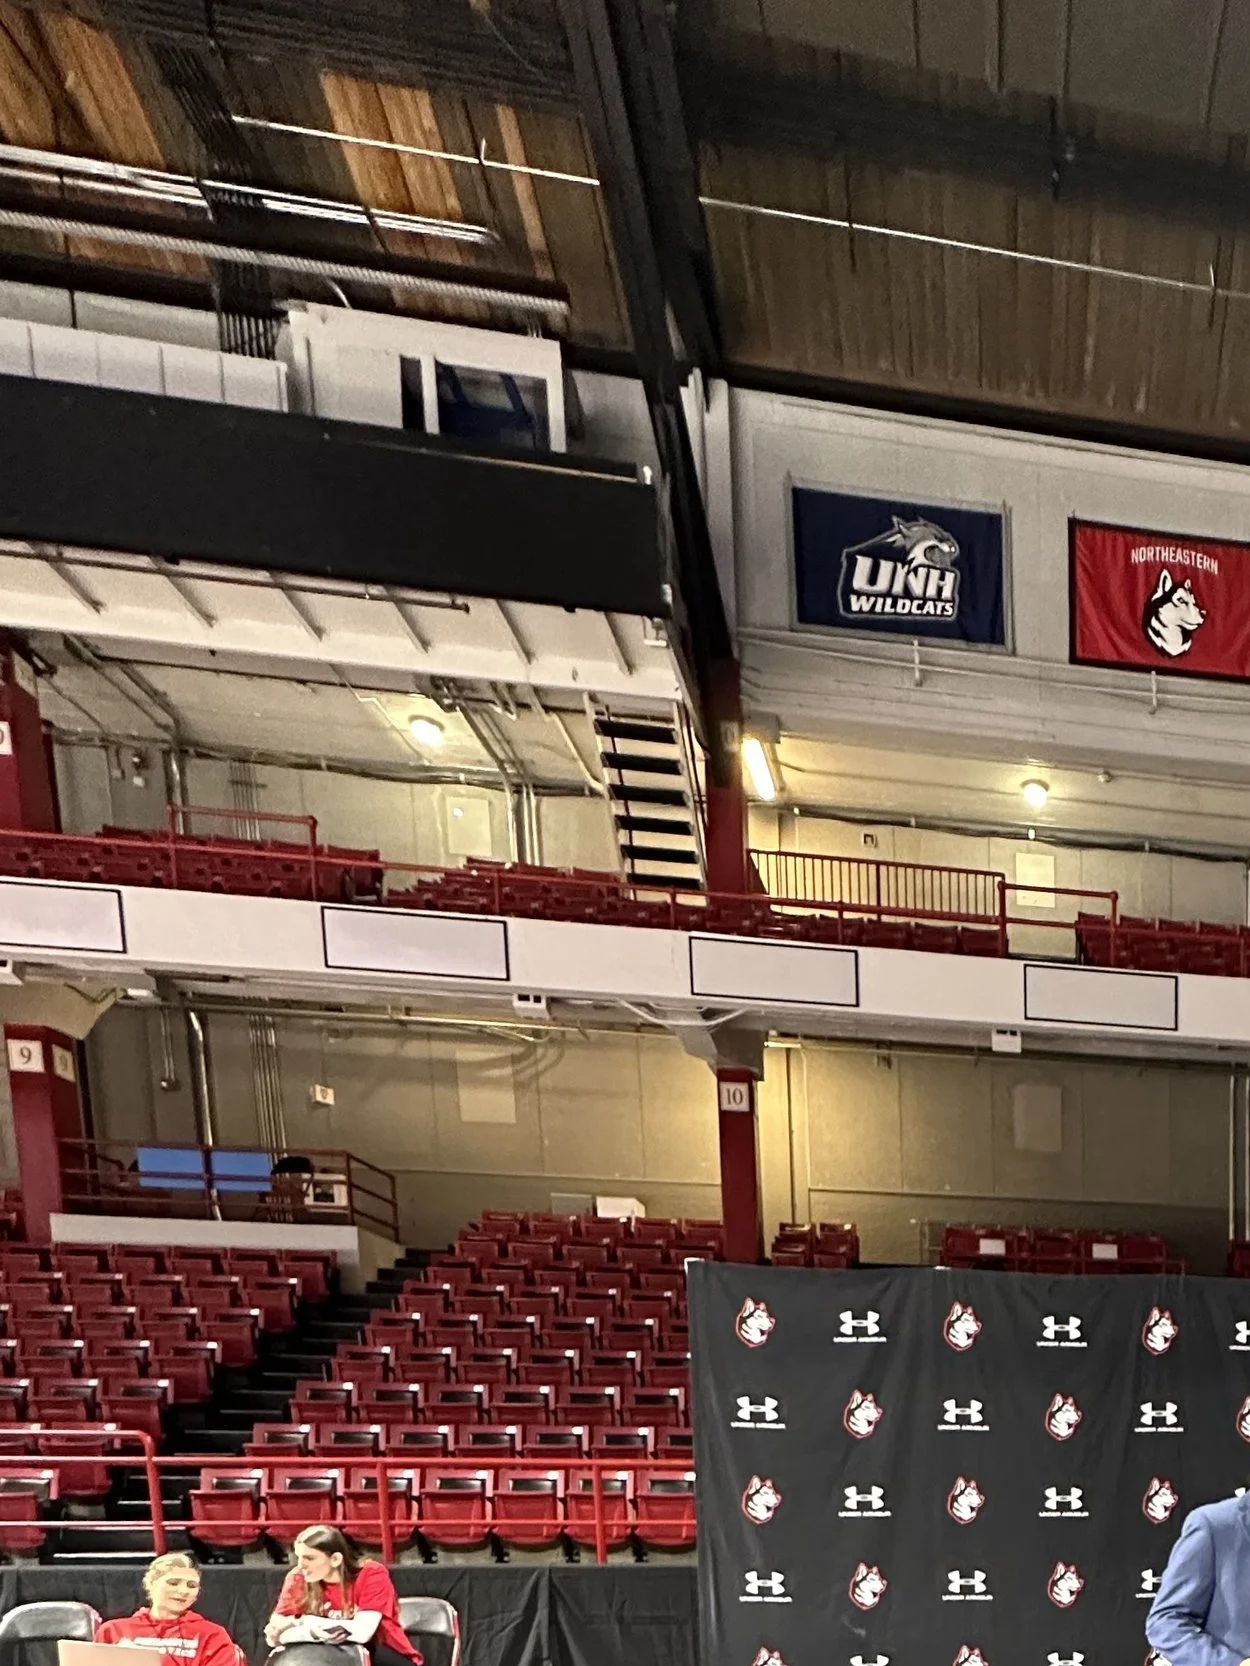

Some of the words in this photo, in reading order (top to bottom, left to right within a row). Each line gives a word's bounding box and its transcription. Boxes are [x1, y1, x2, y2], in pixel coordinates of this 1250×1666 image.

[1131, 546, 1218, 575] NORTHEASTERN
[852, 554, 956, 600] UNH
[849, 594, 954, 616] WILDCATS
[19, 1046, 32, 1065] 9
[726, 1087, 744, 1106] 10
